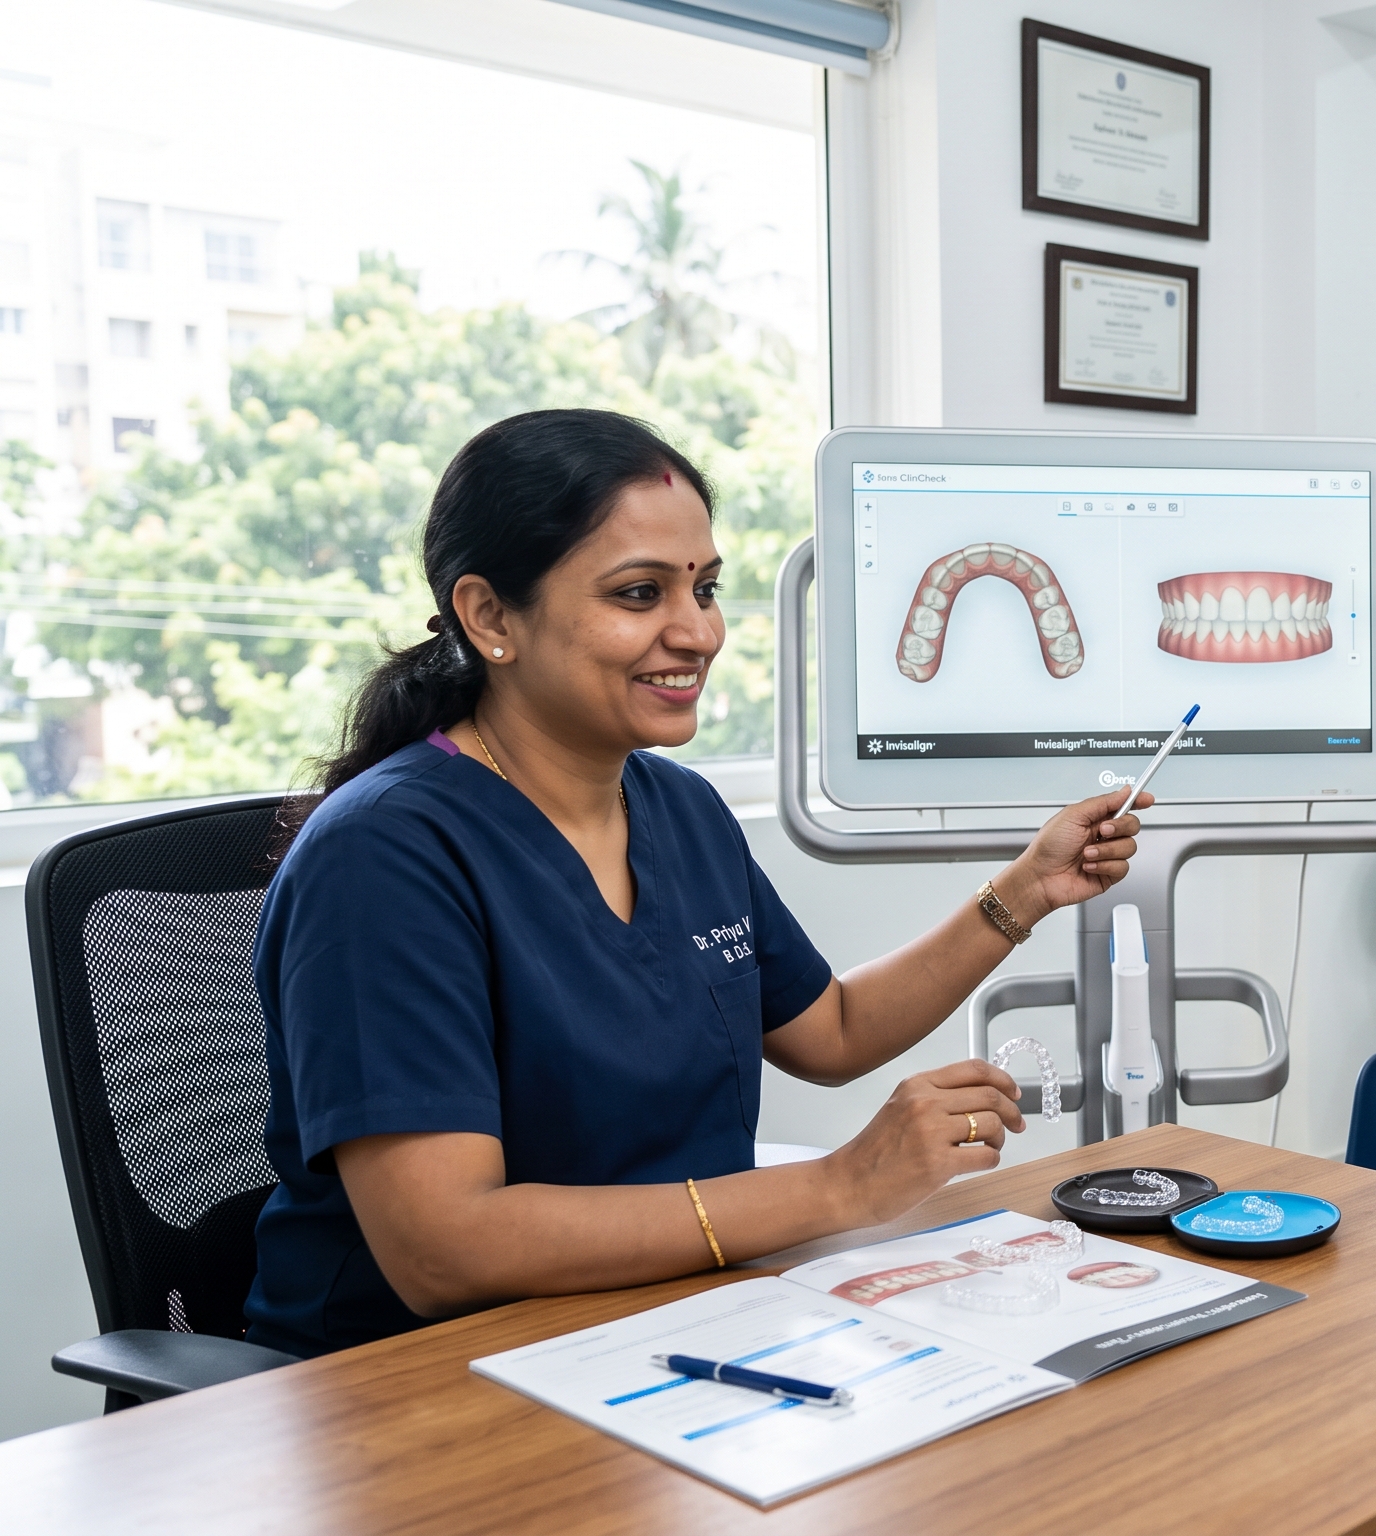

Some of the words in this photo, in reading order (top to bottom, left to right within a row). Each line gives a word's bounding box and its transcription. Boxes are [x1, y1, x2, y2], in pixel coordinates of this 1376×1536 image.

[899, 473, 947, 483] ClinCheck
[1087, 738, 1136, 749] Treatment
[1137, 737, 1159, 748] Plan
[1195, 737, 1206, 748] K.
[692, 935, 714, 950] Dr.
[710, 923, 744, 943] Priya
